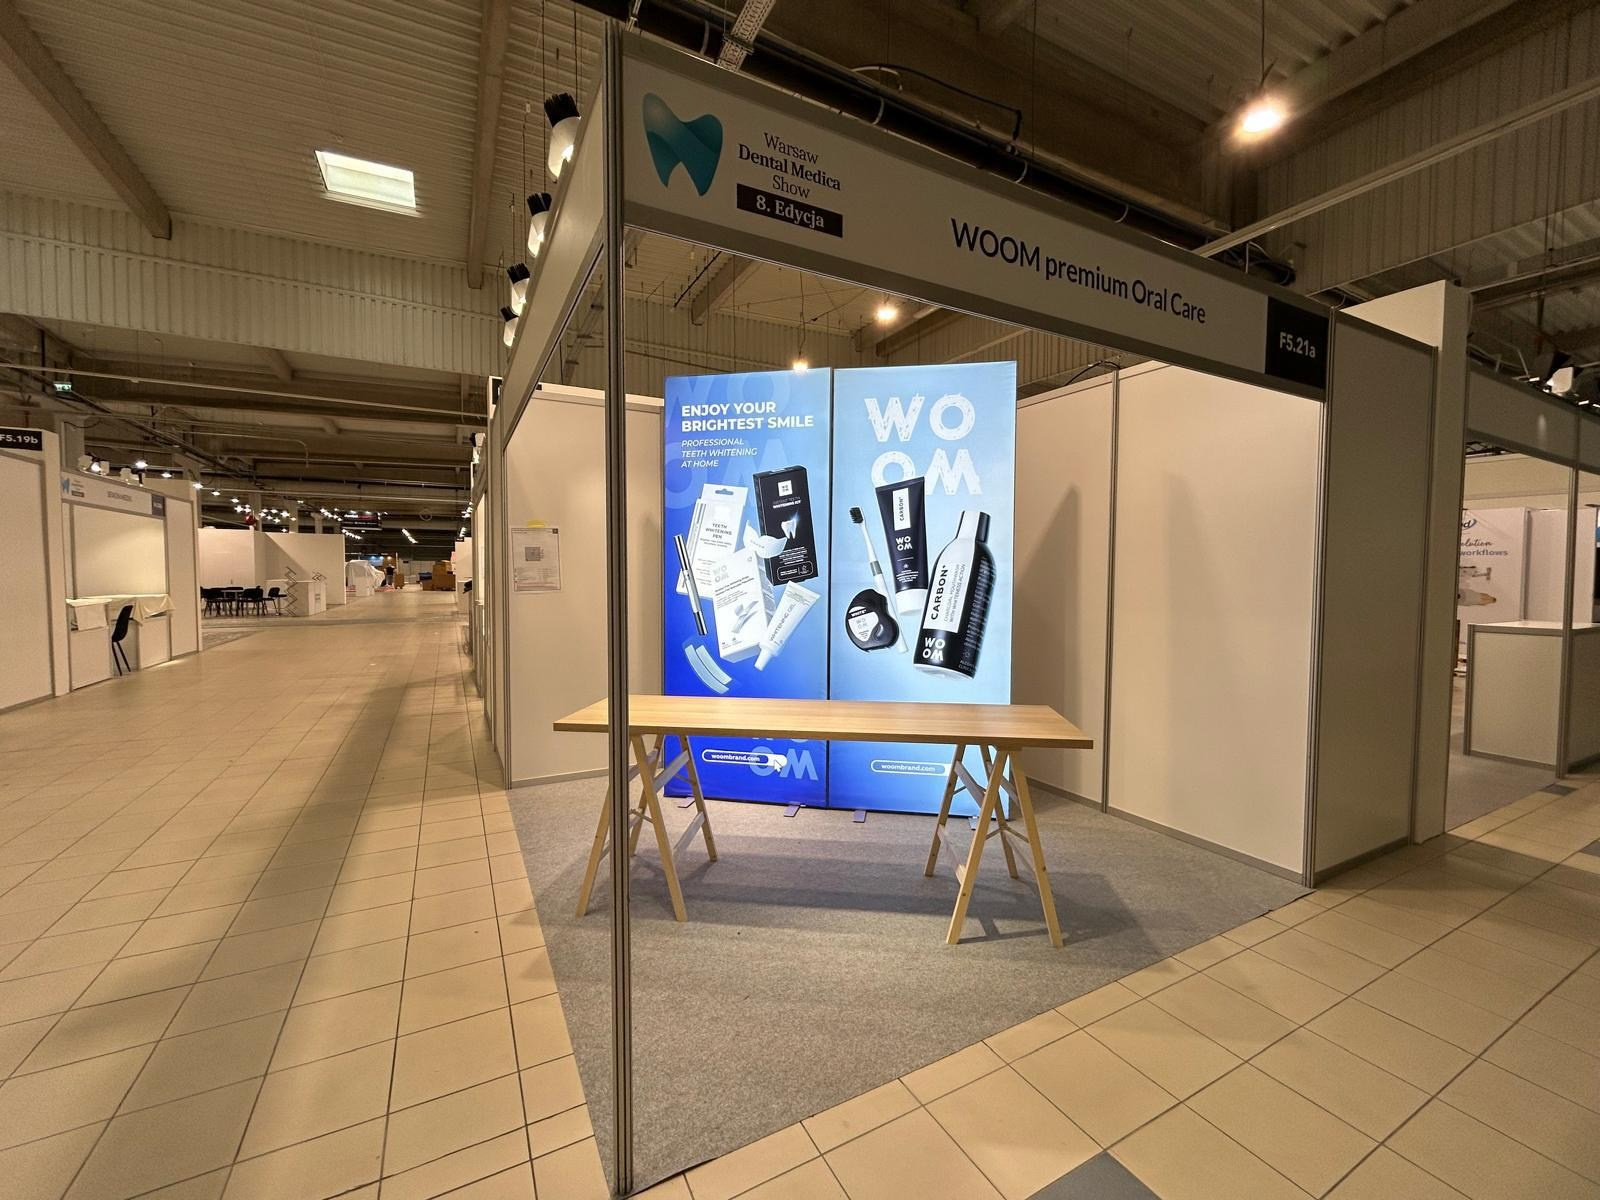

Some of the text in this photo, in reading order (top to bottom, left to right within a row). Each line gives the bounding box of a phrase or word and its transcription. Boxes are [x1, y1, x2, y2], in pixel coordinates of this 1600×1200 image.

[763, 132, 818, 164] Warsaw
[738, 143, 840, 191] Dental Medica
[772, 174, 810, 198] Show
[756, 194, 824, 228] 8. Edycja
[951, 218, 1206, 324] WOOM premium Oral Care
[1280, 331, 1316, 358] F5.21a
[681, 402, 776, 417] ENJOY YOUR
[681, 416, 814, 432] BRIGHTEST SMILE
[864, 393, 976, 442] WO
[0, 434, 38, 444] F5.19b
[681, 438, 744, 448] PROFESSIONAL
[682, 448, 758, 458] TEETH WHITENING
[693, 460, 719, 468] HOME
[896, 536, 911, 544] WO
[897, 543, 912, 551] OM
[924, 638, 945, 649] WO
[922, 648, 944, 661] OM
[711, 753, 760, 762] woombrand.com
[881, 763, 936, 772] woombrand.com
